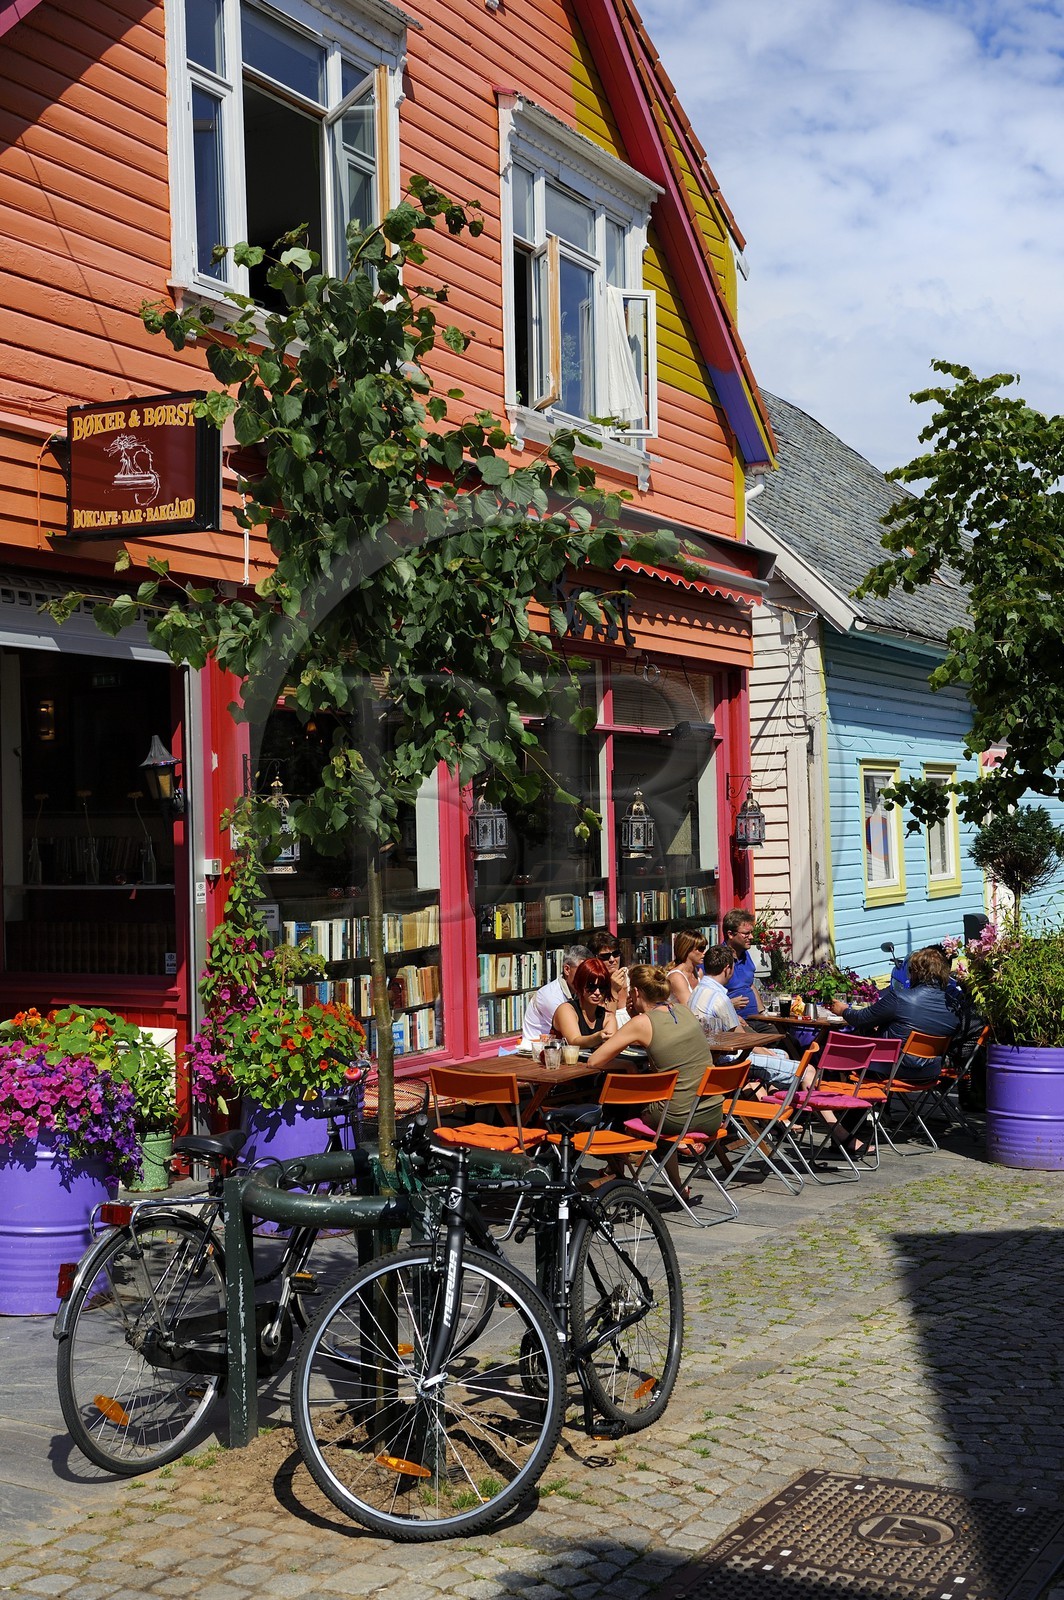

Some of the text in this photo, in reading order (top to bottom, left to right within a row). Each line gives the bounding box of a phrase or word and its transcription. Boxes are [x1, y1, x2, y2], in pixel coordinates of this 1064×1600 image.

[72, 402, 196, 442] BØKER & BØRST
[443, 1249, 458, 1328] MERIDA
